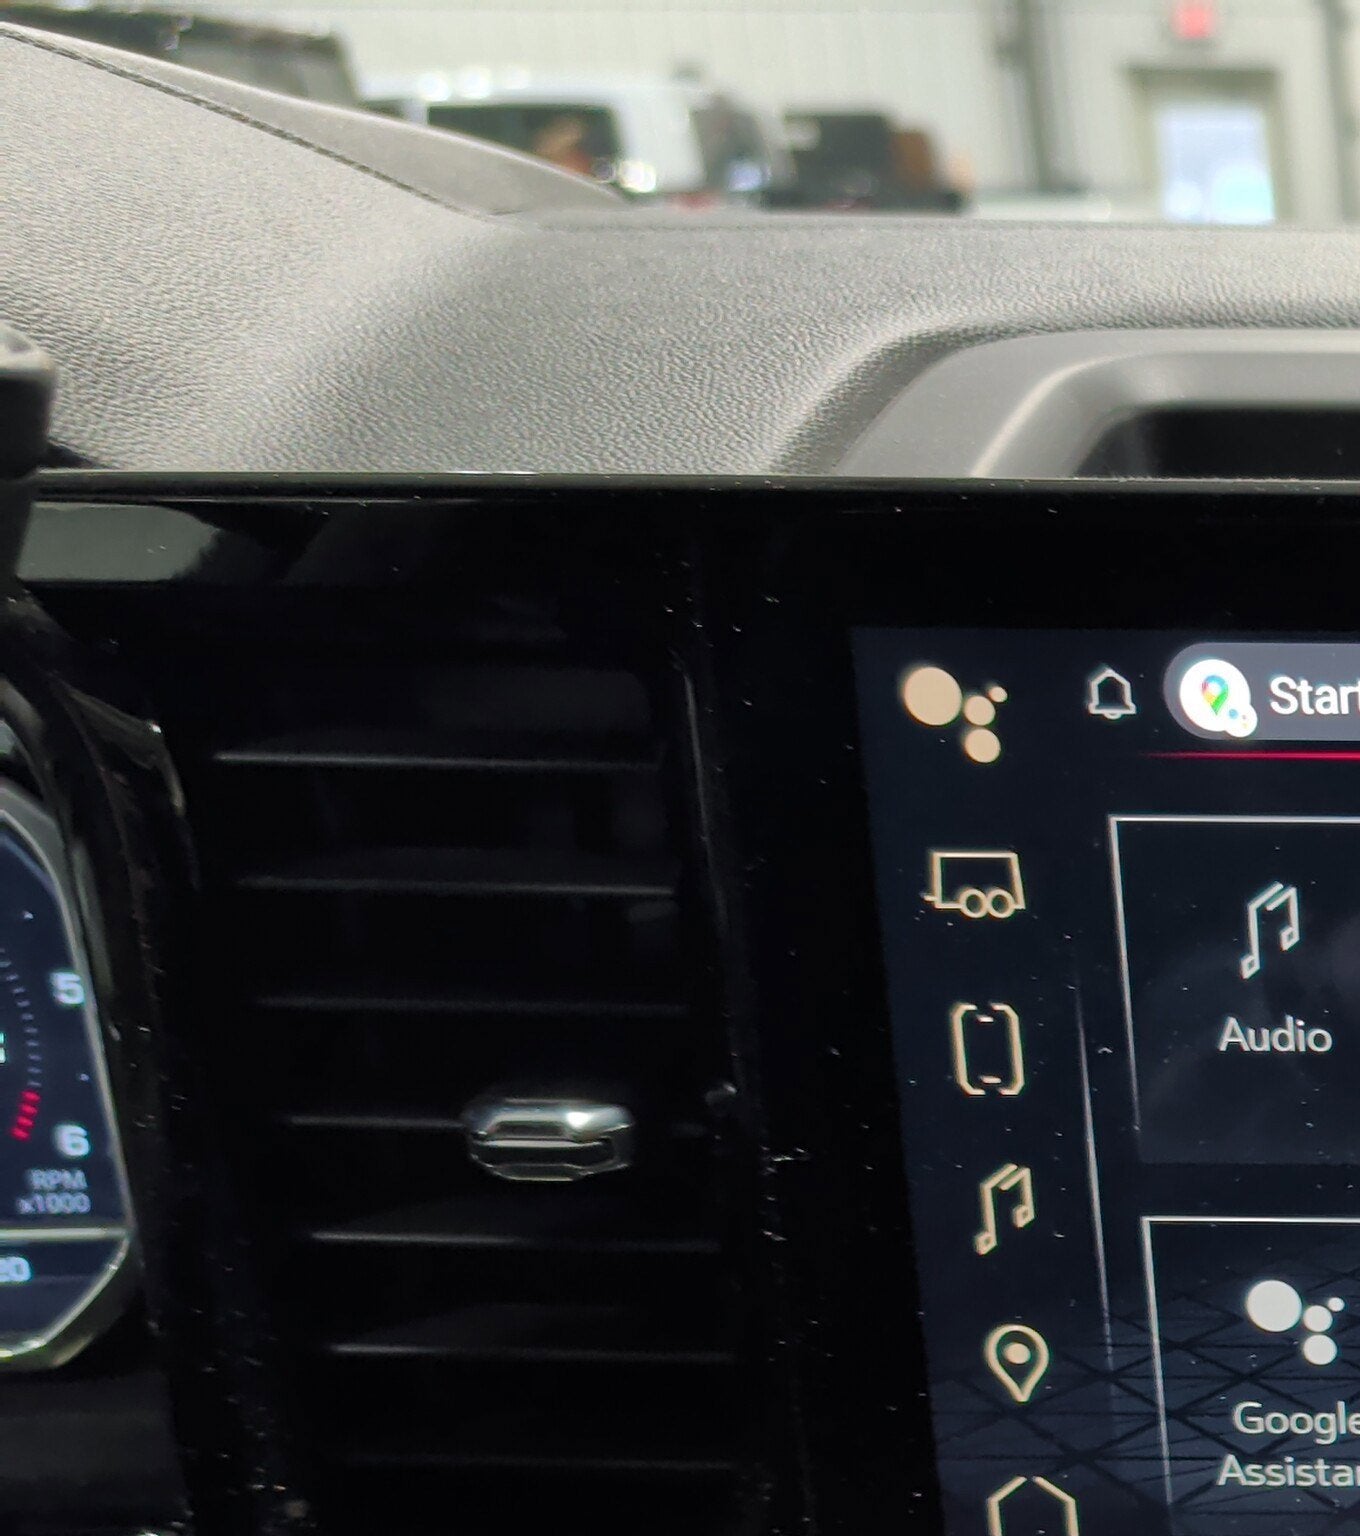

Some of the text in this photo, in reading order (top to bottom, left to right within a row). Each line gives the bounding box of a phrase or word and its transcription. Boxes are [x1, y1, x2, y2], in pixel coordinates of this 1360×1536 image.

[51, 971, 85, 1005] 5
[1218, 1014, 1333, 1053] Audio
[55, 1124, 90, 1157] 6
[28, 1168, 88, 1190] RPM
